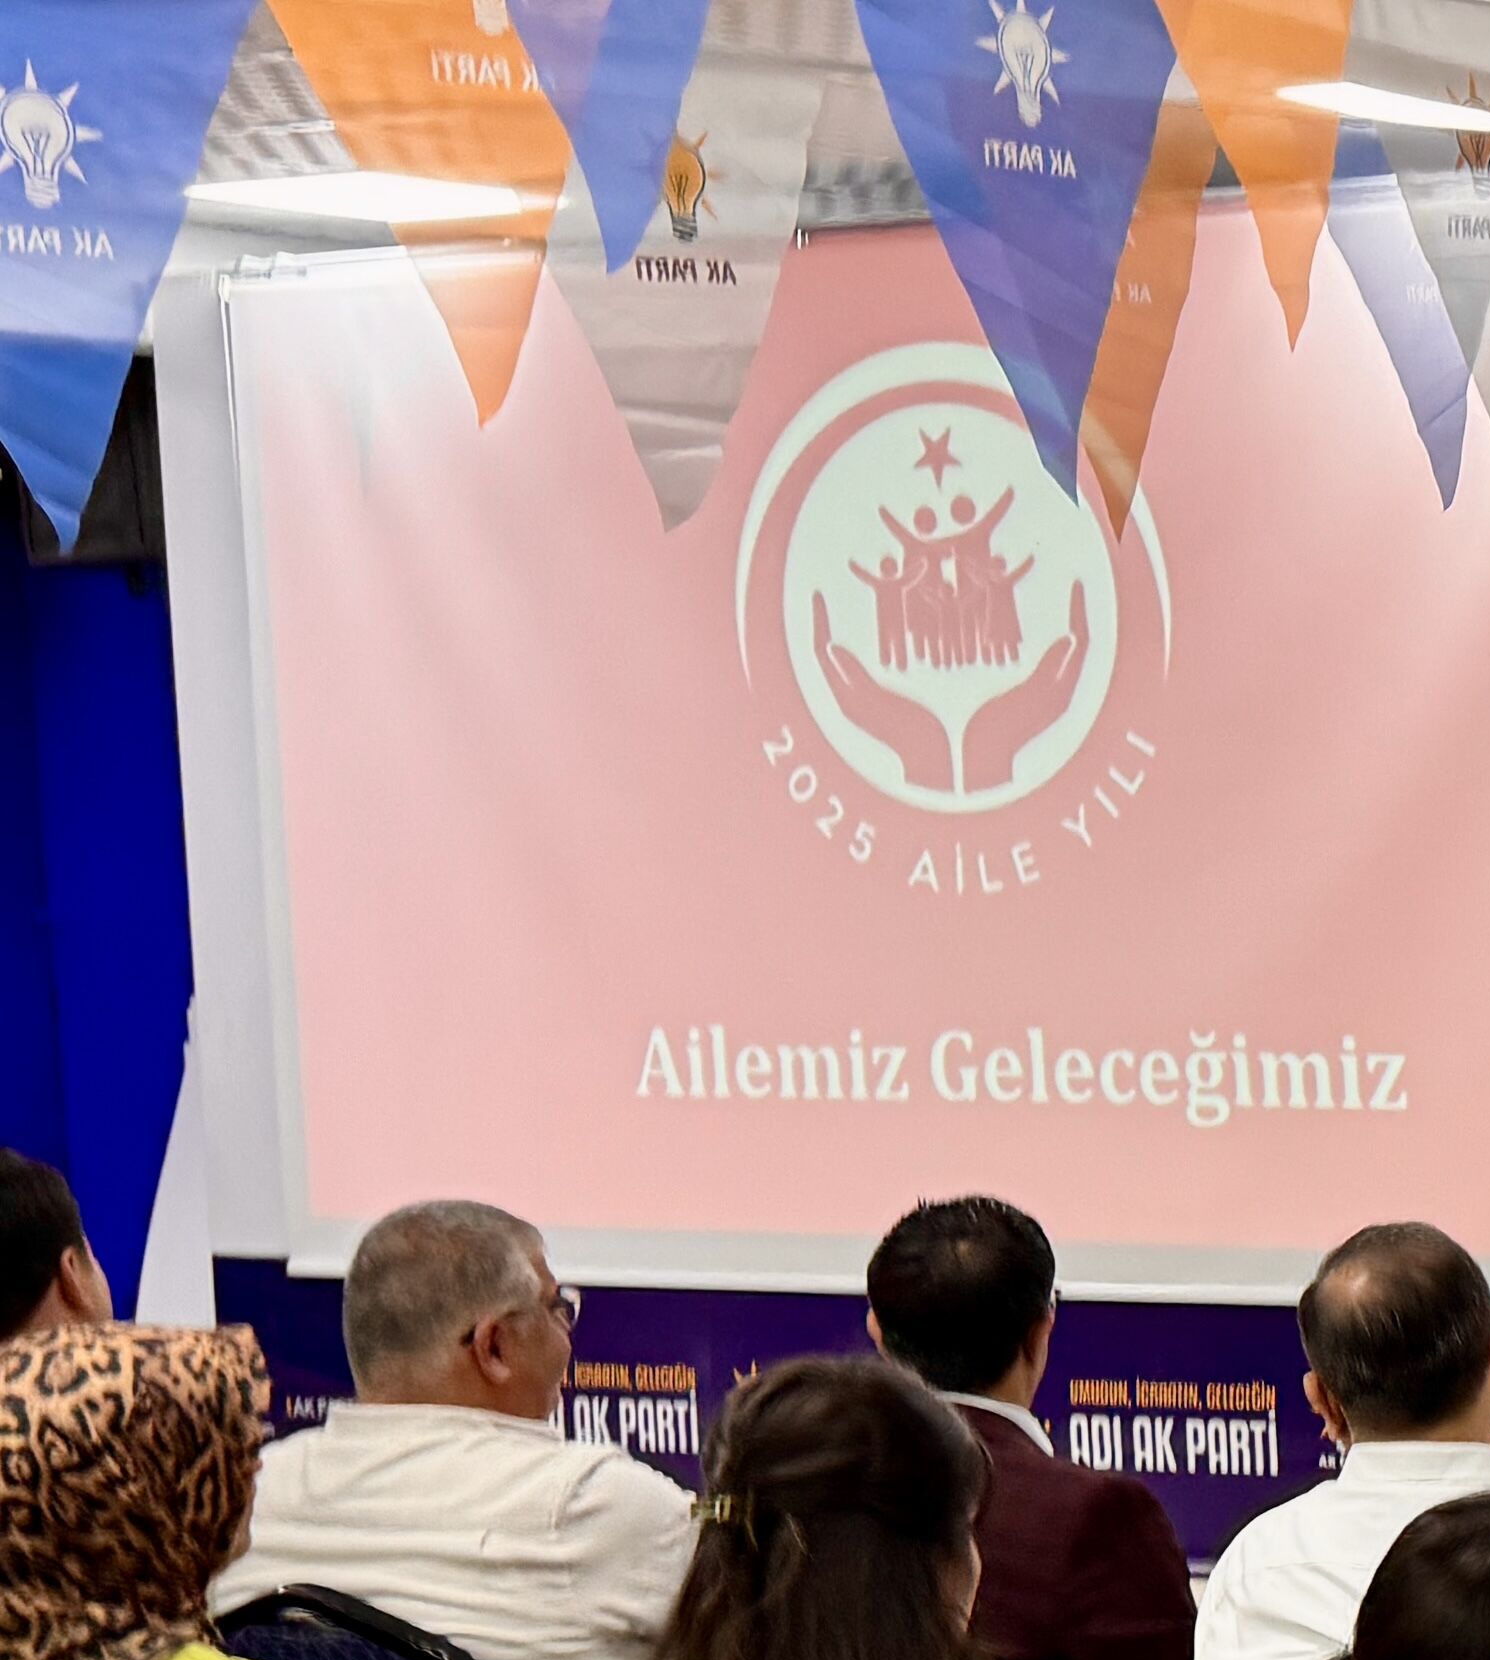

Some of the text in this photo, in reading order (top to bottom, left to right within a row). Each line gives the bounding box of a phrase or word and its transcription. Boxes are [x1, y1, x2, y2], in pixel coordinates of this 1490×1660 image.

[761, 724, 877, 863] 2025
[1060, 730, 1156, 849] YILI
[635, 1023, 1411, 1128] Ailemiz Geleceğimiz
[1069, 1412, 1124, 1472] ADI
[1132, 1414, 1177, 1474] AK
